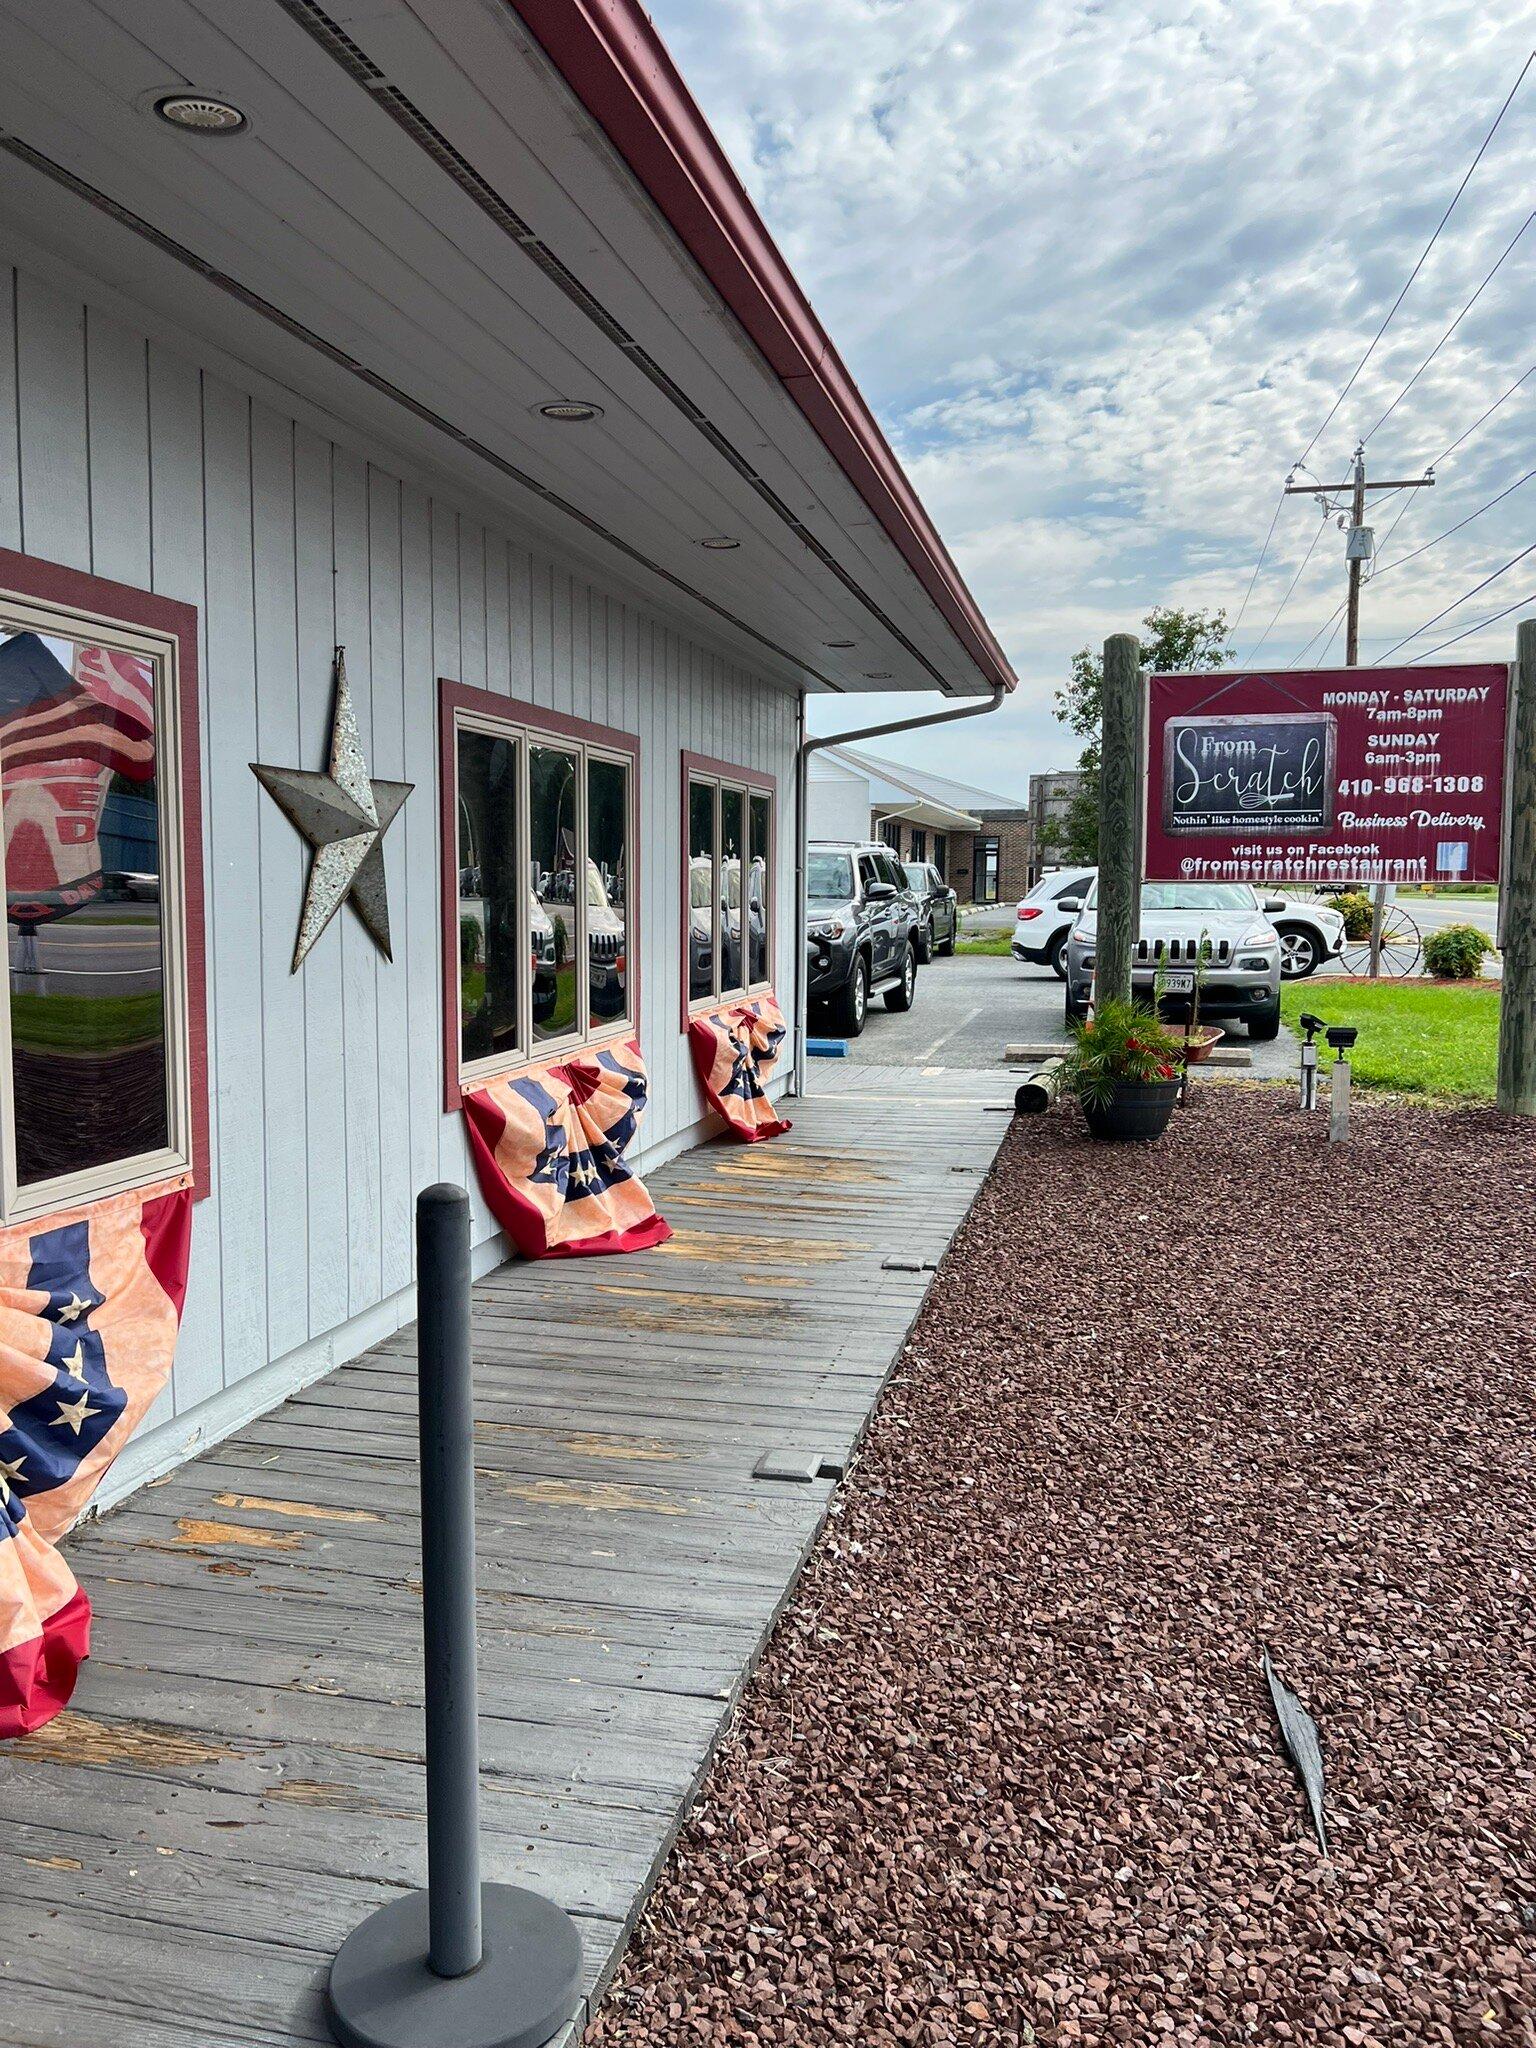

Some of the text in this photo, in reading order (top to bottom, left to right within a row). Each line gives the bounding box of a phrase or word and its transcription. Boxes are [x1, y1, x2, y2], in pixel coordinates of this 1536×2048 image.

[1323, 691, 1390, 705] MONDAY
[1403, 687, 1490, 702] SATURDAY
[1366, 707, 1443, 721] 7am-8pm
[1201, 736, 1257, 752] From
[1367, 733, 1440, 747] SUNDAY
[1176, 727, 1322, 804] Scratch
[1365, 751, 1441, 765] 6am-3pm
[1338, 776, 1484, 796] 410-968-1308
[1172, 812, 1322, 826] Nothin' like homestyle cookin'
[1337, 809, 1486, 830] Business Delivery
[1231, 843, 1380, 855] visit us on Facebook
[1180, 856, 1427, 872] @fromscratchrestaurant
